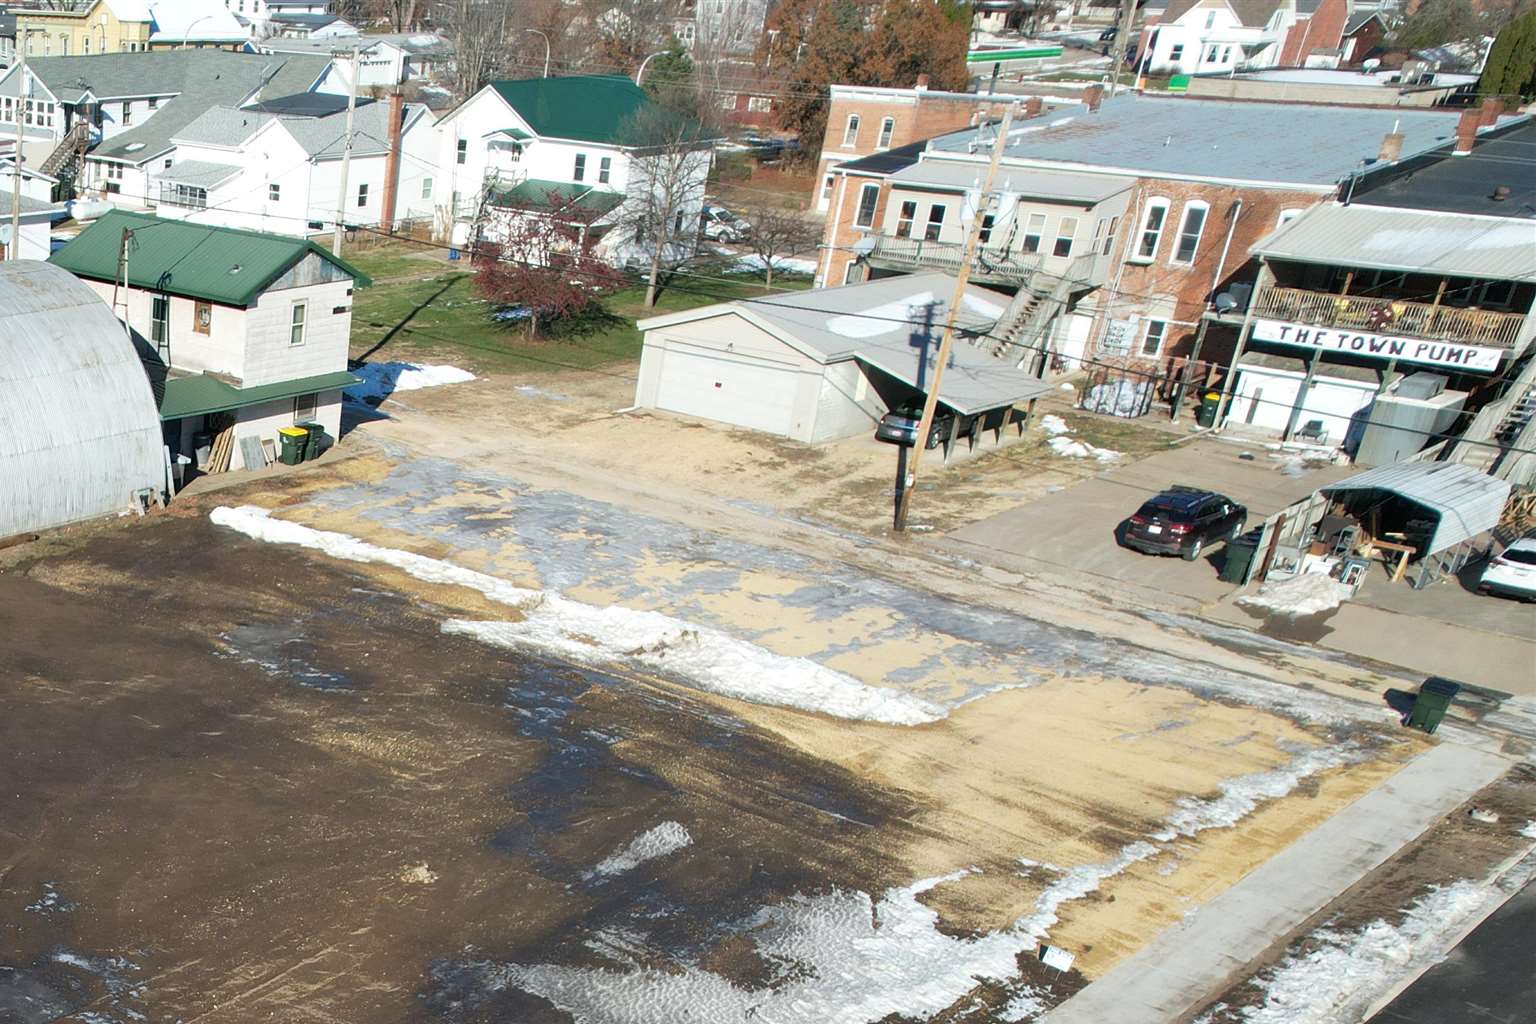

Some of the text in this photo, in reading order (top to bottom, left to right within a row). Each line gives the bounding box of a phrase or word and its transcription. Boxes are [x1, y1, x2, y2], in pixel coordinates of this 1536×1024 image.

[1279, 325, 1479, 365] THE TOWN PUMP
